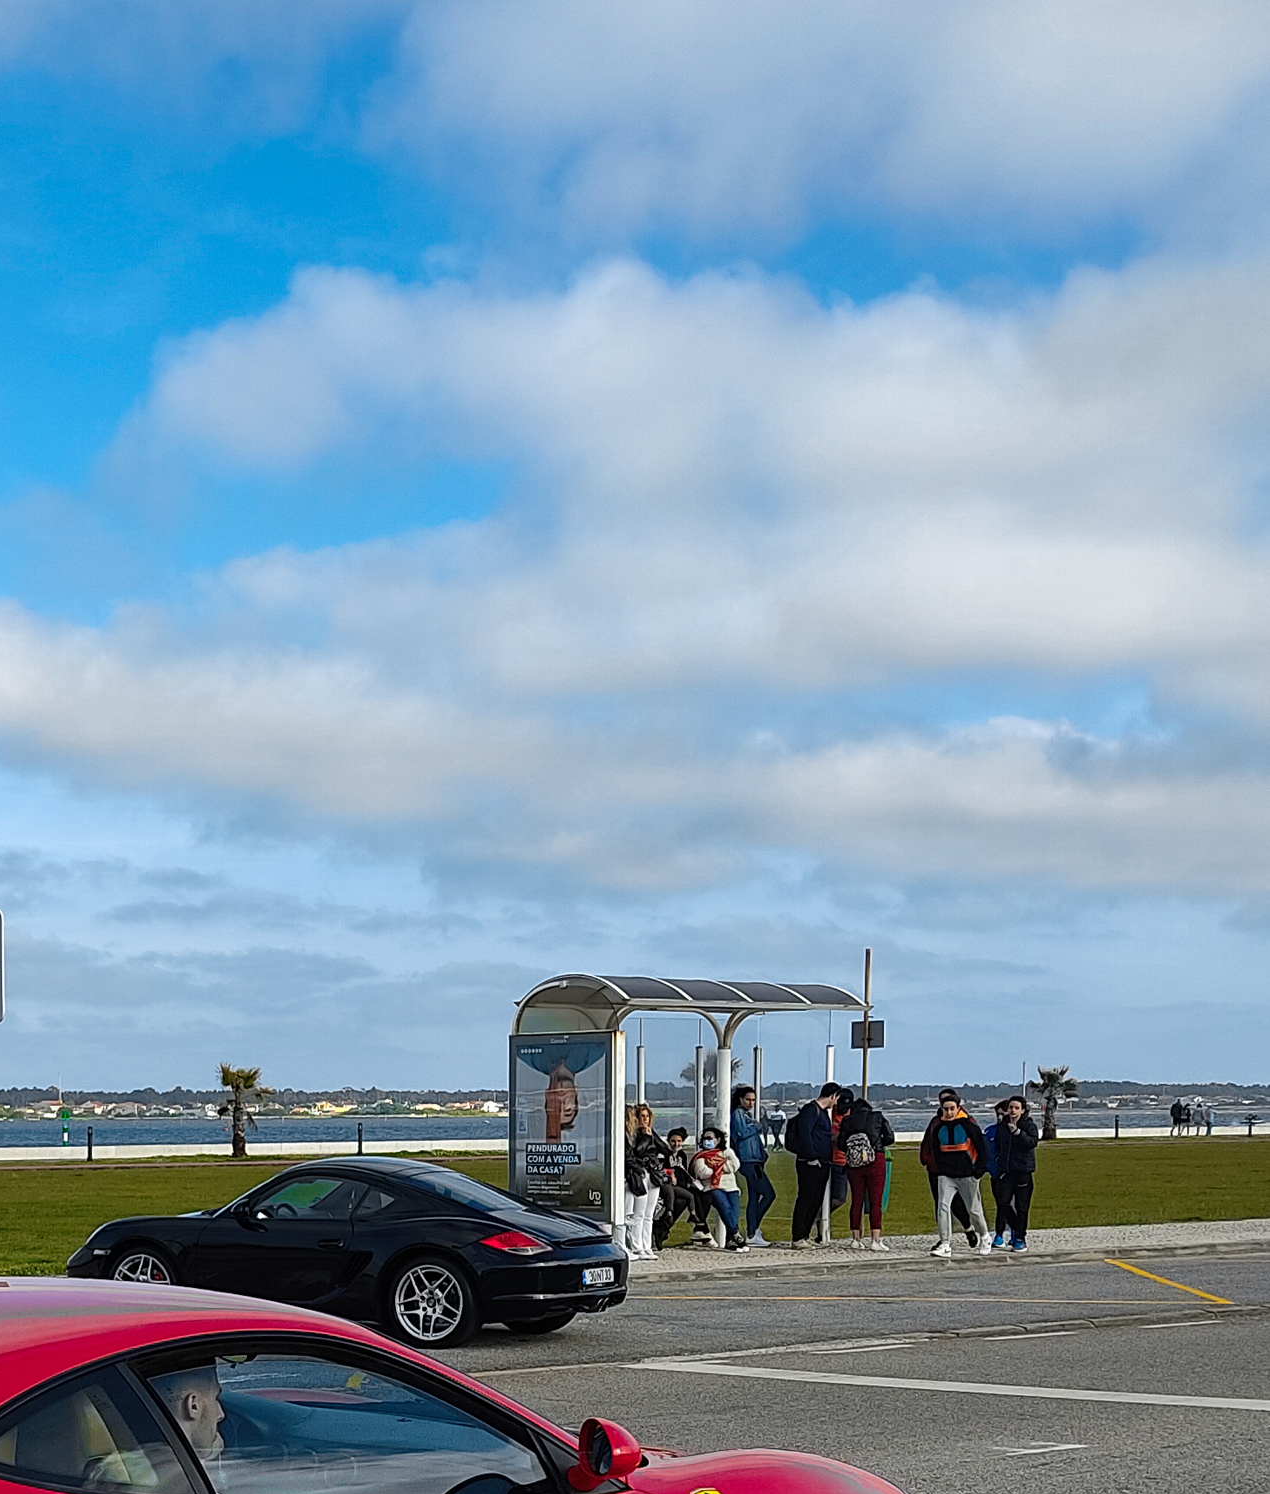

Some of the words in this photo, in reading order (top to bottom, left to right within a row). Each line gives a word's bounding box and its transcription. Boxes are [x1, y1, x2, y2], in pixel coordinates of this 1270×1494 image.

[527, 1144, 575, 1153] PENDURADO
[527, 1155, 545, 1163] COM
[546, 1155, 552, 1163] A
[553, 1155, 580, 1163] VENDA
[527, 1166, 538, 1174] DA
[539, 1166, 563, 1174] CASA?
